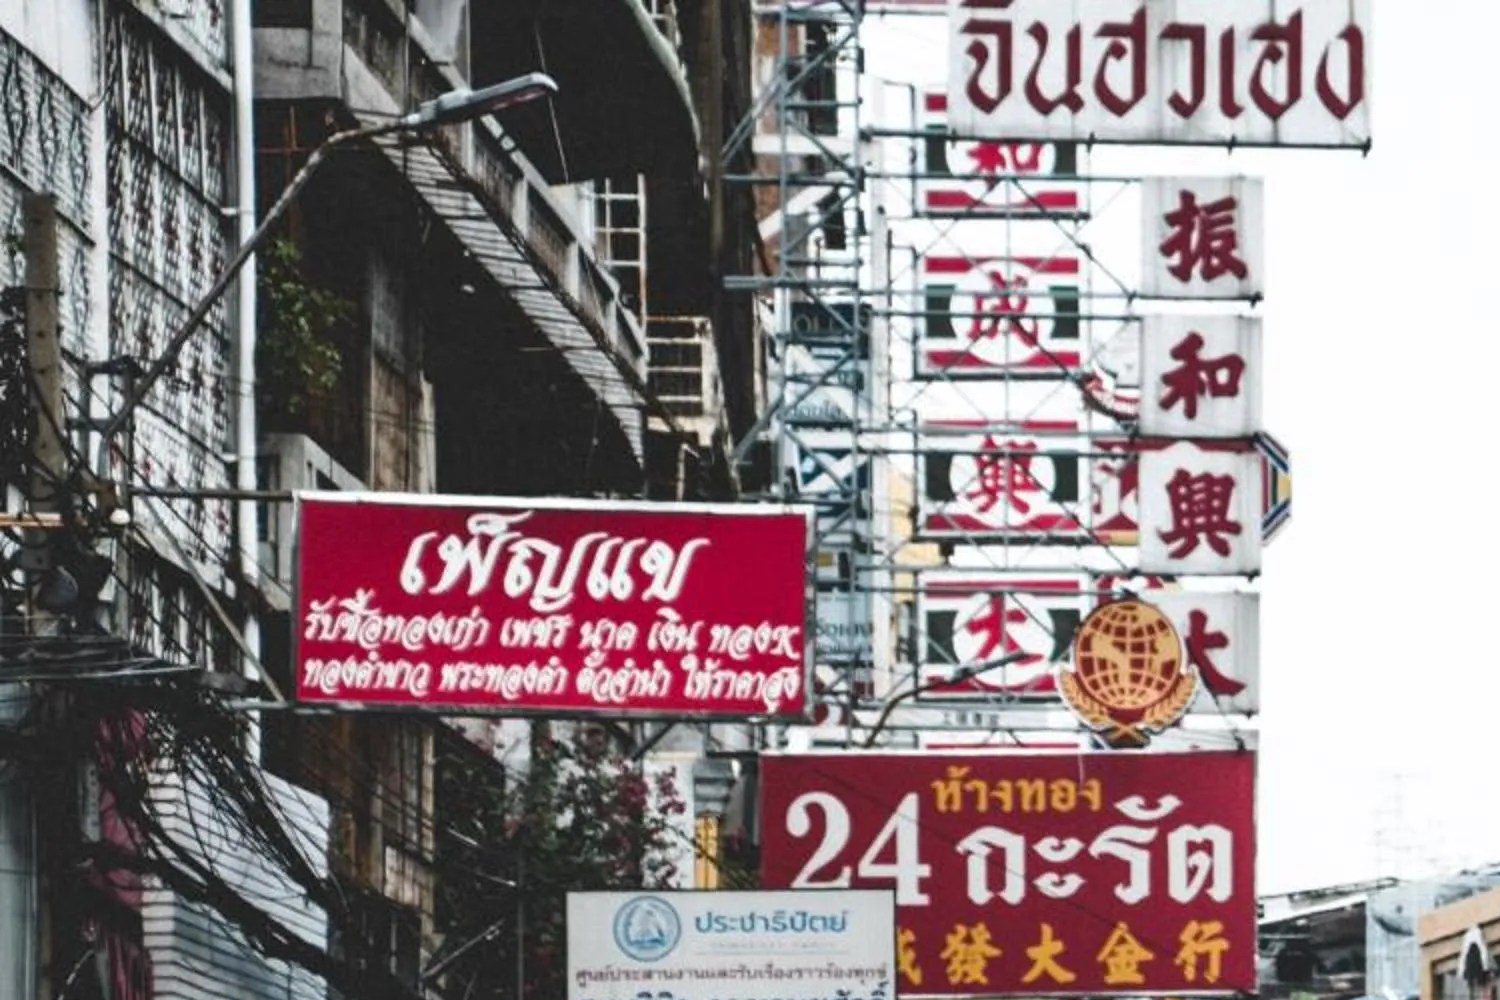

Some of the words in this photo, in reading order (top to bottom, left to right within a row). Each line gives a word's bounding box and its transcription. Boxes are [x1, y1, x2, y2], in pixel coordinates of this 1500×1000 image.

[931, 765, 1102, 813] ห้างทอง
[785, 791, 931, 906] 24
[955, 793, 1235, 906] กะรัต
